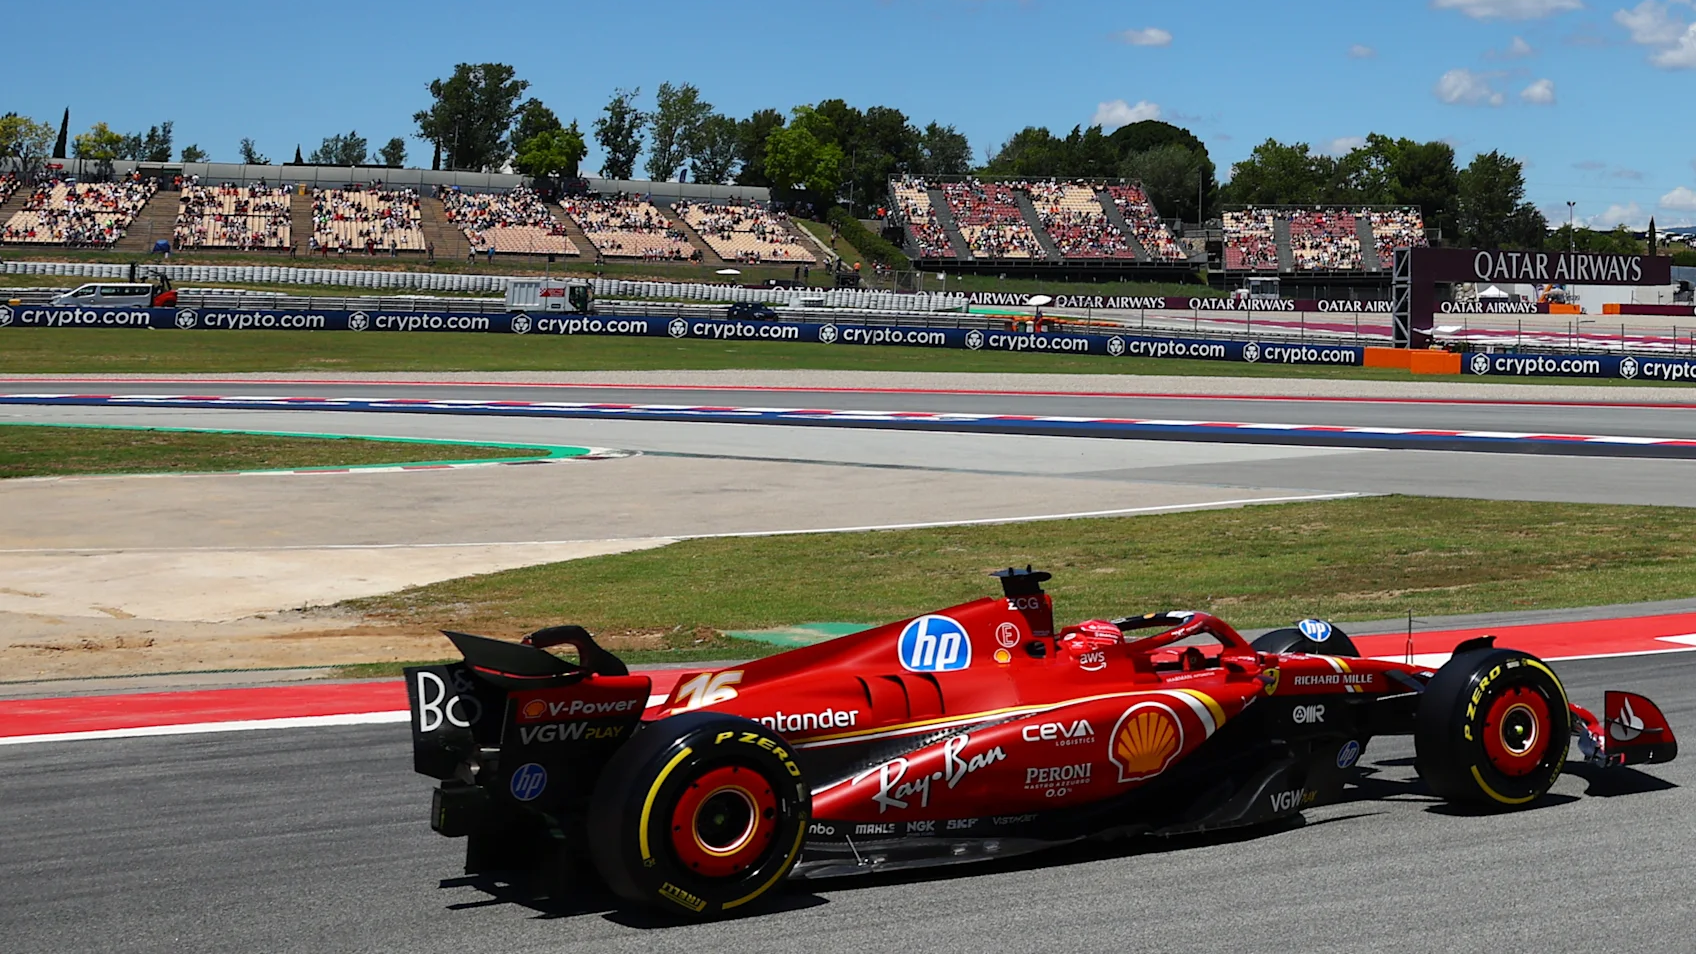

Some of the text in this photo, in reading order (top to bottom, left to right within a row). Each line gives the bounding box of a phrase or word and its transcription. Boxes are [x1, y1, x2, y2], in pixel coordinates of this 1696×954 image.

[1474, 250, 1642, 282] QATAR AIRWAYS
[968, 292, 1030, 305] AIRWAYS
[1055, 295, 1165, 309] QATAR AIRWAYS
[1189, 298, 1295, 311] QATAR AIRWAYS
[1318, 300, 1362, 312] QATAR
[1441, 301, 1538, 314] QATAR AIRWAYS
[21, 308, 150, 326] crypto.com
[204, 310, 326, 329] crypto.com
[375, 312, 489, 331] crypto.com
[537, 316, 648, 334] crypto.com
[693, 321, 799, 339] crypto.com
[843, 326, 946, 345] crypto.com
[988, 332, 1089, 351] crypto.com
[1129, 338, 1225, 358] crypto.com
[1264, 344, 1356, 363] crypto.com
[1495, 356, 1600, 375] crypto.com
[1303, 619, 1330, 642] hp
[910, 618, 962, 671] hp
[1080, 651, 1105, 664] aws
[1294, 673, 1373, 686] RICHARD MILLE
[671, 669, 745, 715] 16
[549, 698, 637, 717] V-Power
[1464, 664, 1501, 742] P ZERO
[1055, 737, 1096, 747] LOGISTICS
[714, 731, 801, 777] P ZERO
[513, 763, 546, 801] hp
[1025, 762, 1092, 784] PERONI
[855, 823, 896, 835] MAHLE
[906, 820, 936, 833] NGK
[946, 818, 979, 830] SKF
